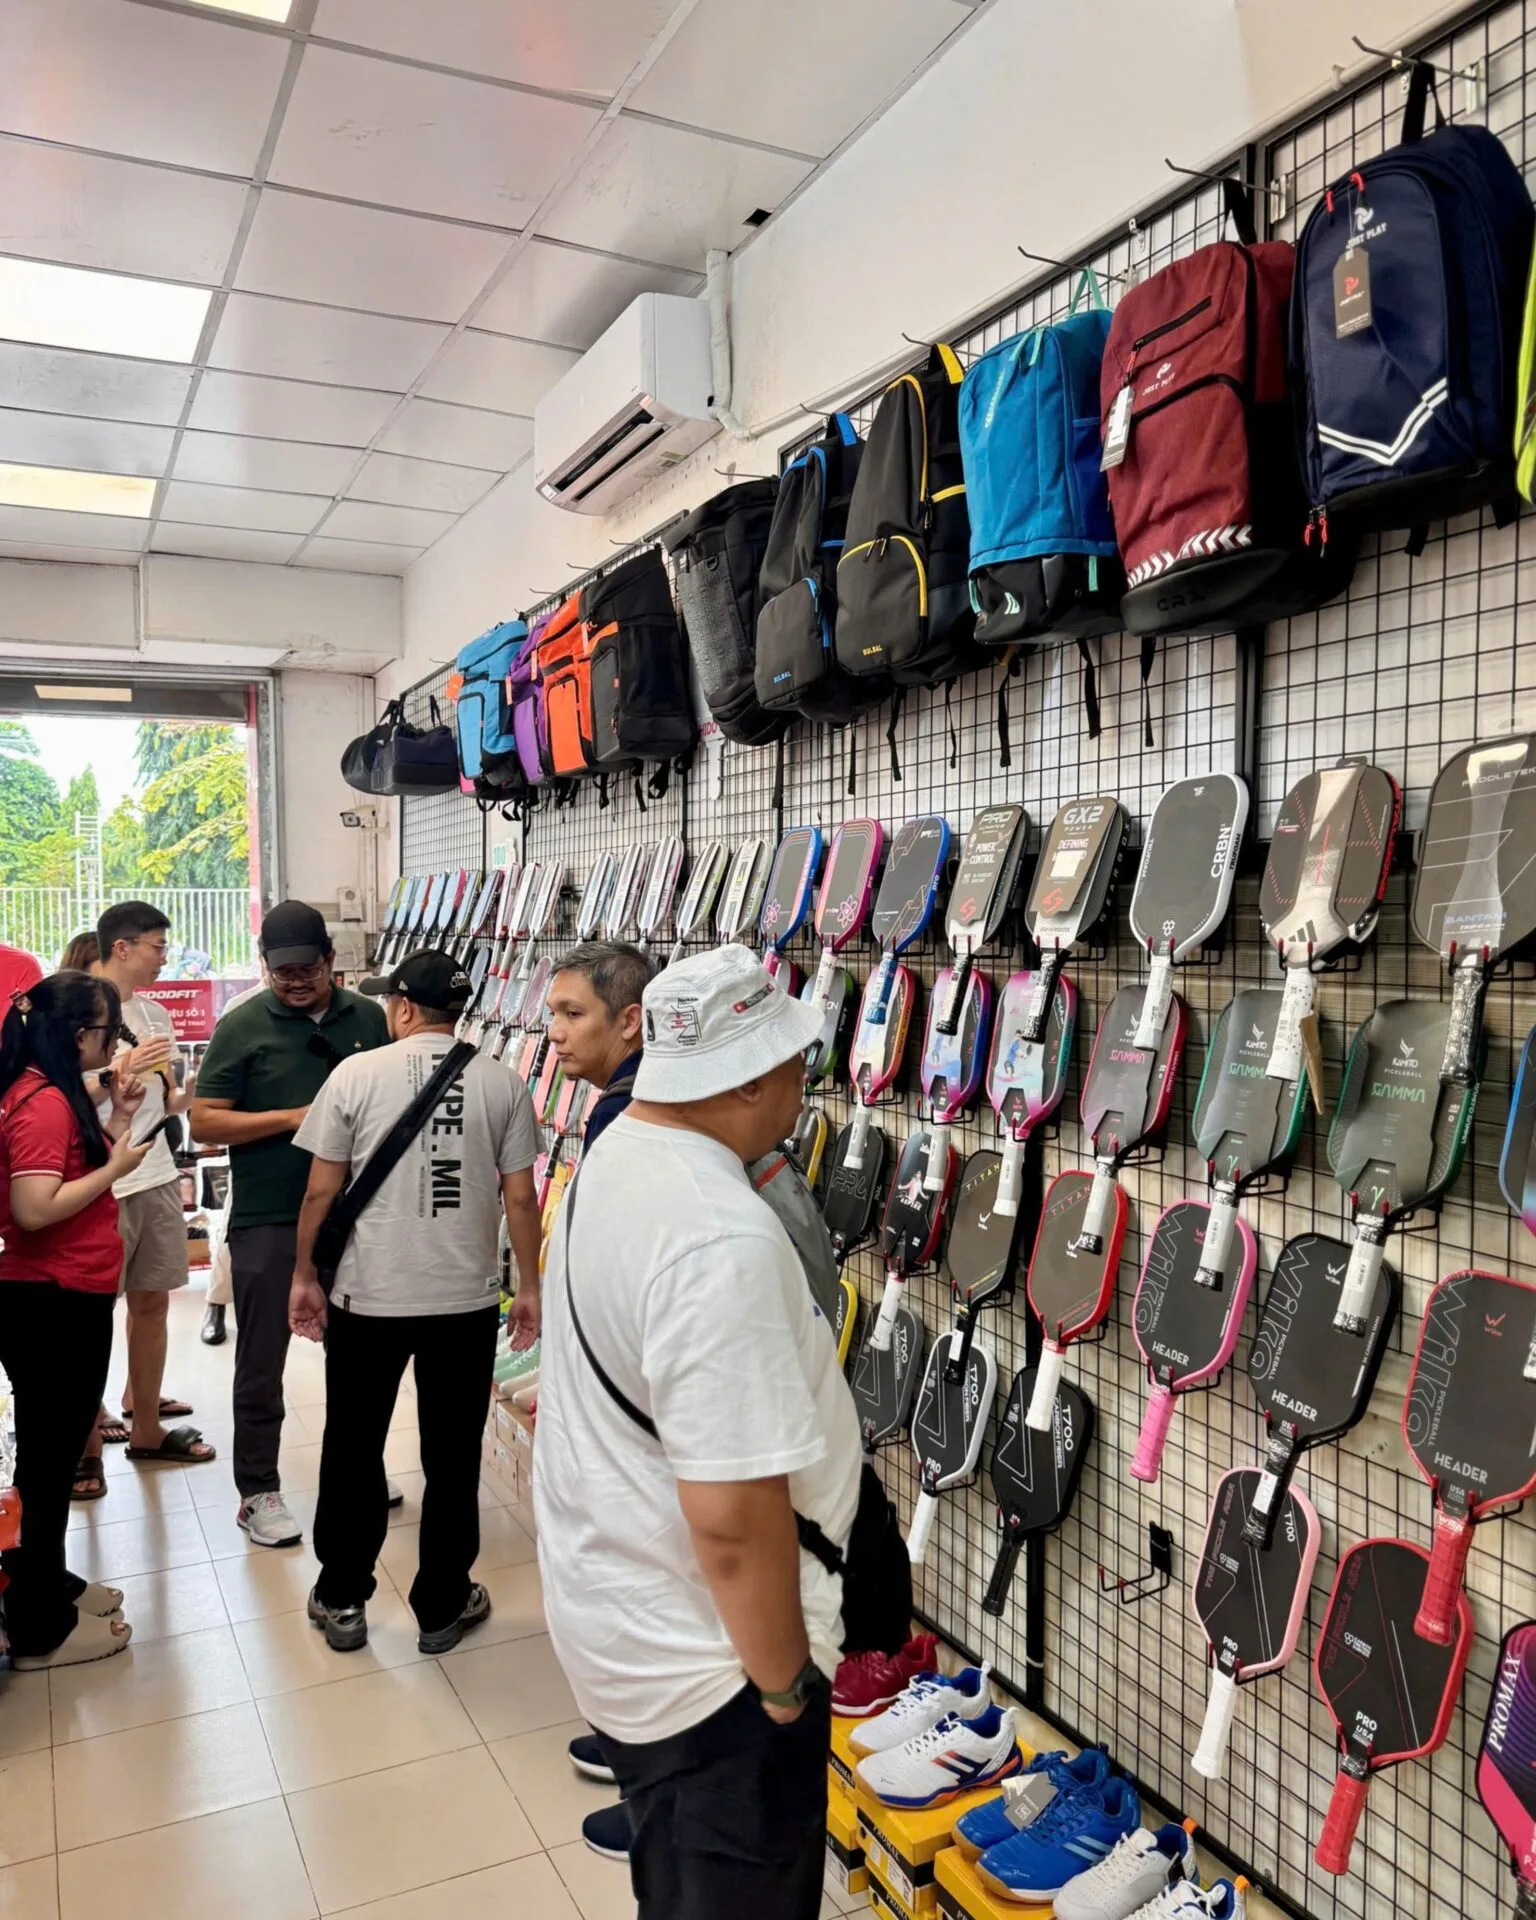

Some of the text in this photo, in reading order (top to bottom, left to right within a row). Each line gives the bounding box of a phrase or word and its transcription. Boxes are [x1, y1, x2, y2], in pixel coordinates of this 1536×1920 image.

[1366, 223, 1387, 240] PLAY
[1462, 767, 1536, 787] PDDLETEK
[1063, 805, 1105, 825] GX2
[1109, 1050, 1145, 1064] GAMMA
[1391, 1057, 1419, 1069] KAMITO
[1371, 1082, 1426, 1104] GAMMA
[966, 1162, 1000, 1191] TITAN
[1050, 1183, 1091, 1218] TITAN
[1151, 1292, 1165, 1333] PICKLEBALL
[899, 1325, 908, 1364] T700
[1152, 1341, 1190, 1367] HEADER
[1268, 1334, 1288, 1382] PICKLEBALL
[968, 1364, 979, 1406] T700
[1271, 1389, 1319, 1423] HEADER
[1428, 1390, 1446, 1447] PICKLEBALL
[1054, 1396, 1064, 1469] CARBON FIBER
[1061, 1405, 1074, 1451] T700
[925, 1457, 942, 1473] PRO
[1433, 1451, 1489, 1485] HEADER
[1450, 1484, 1465, 1497] USA
[1284, 1510, 1296, 1542] T700
[1222, 1635, 1238, 1652] PRO
[1486, 1651, 1522, 1752] PROMAX
[1355, 1710, 1378, 1732] PRO
[1356, 1725, 1374, 1742] USA
